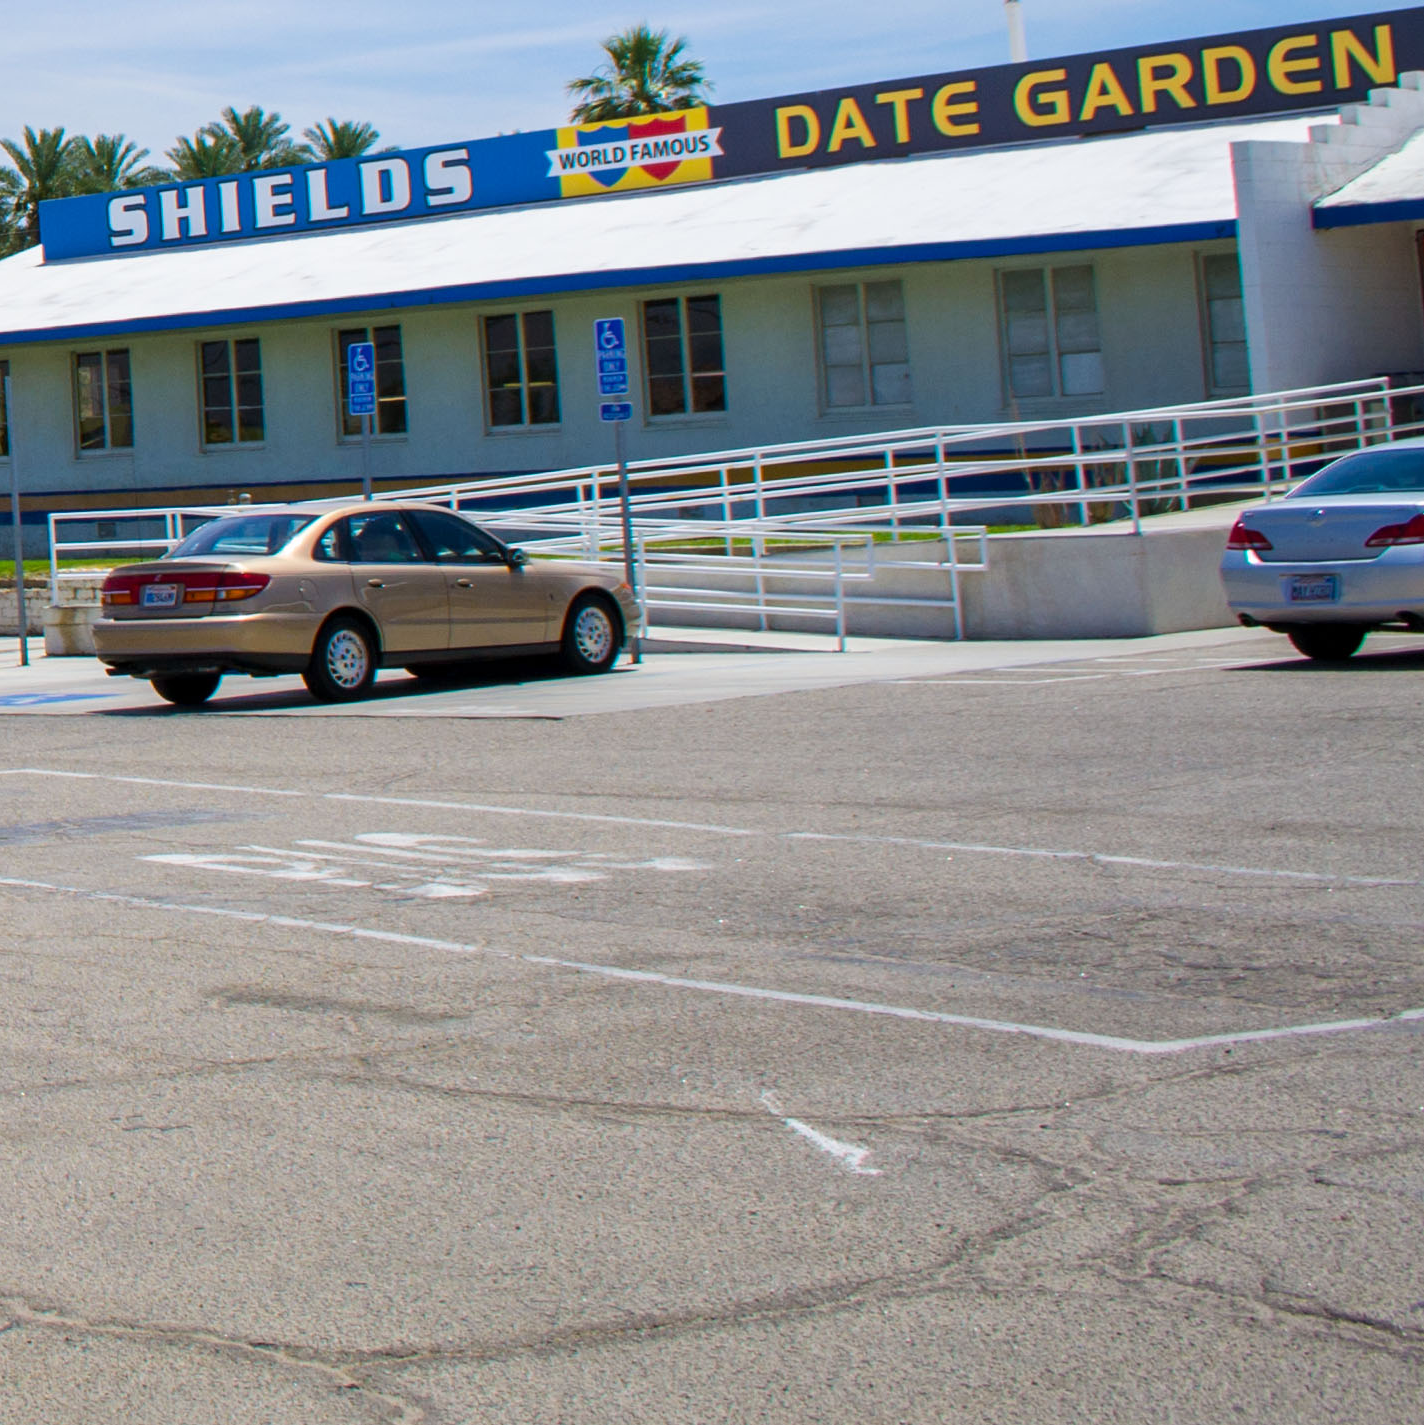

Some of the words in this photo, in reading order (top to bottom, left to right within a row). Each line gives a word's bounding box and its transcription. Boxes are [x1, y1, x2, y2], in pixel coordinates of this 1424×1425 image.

[774, 80, 981, 159] DATE
[1013, 24, 1396, 128] GARDEN
[107, 148, 473, 248] SHIELDS
[559, 146, 627, 170] WORLD
[629, 134, 710, 161] FAMOUS
